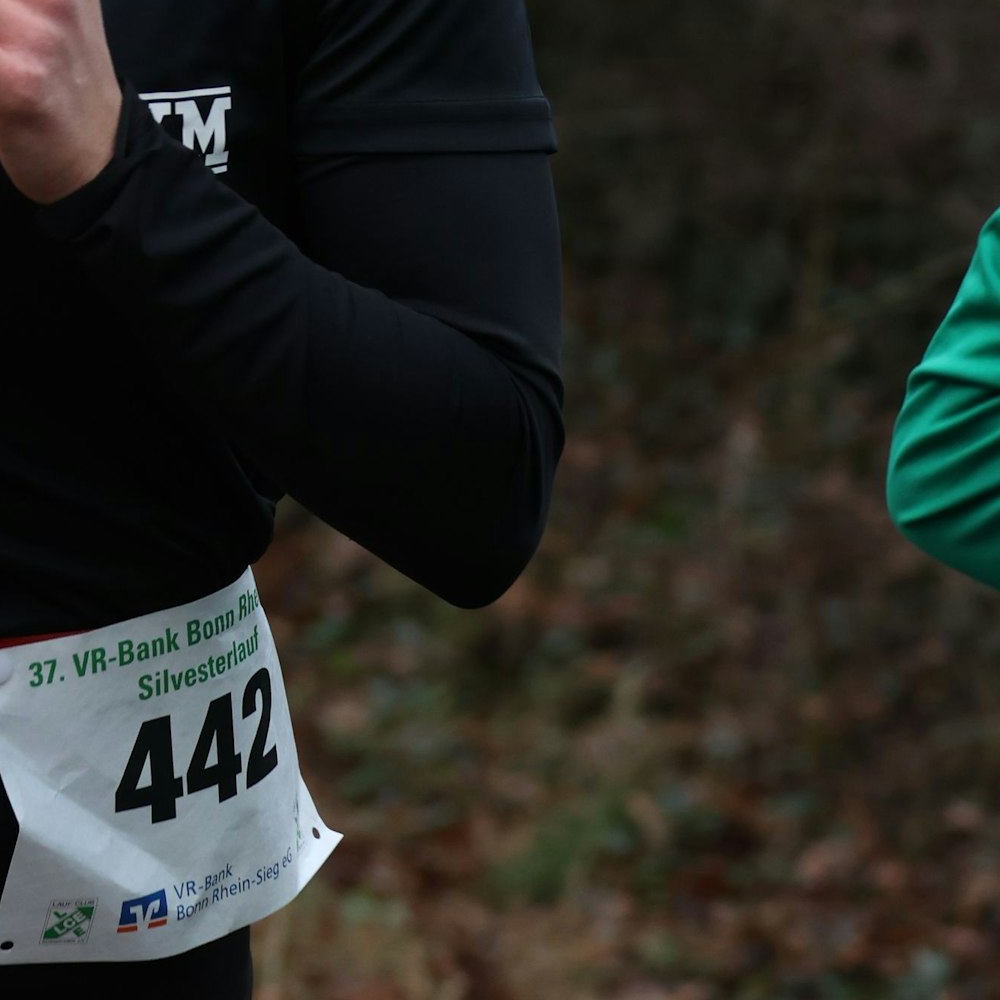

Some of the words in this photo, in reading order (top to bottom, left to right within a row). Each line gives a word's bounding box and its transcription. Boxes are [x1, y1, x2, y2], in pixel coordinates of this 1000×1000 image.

[28, 658, 66, 688] 37.
[72, 627, 181, 678] VR-Bank
[186, 608, 235, 647] Bonn
[138, 624, 259, 701] Silvesterlauf
[114, 667, 279, 825] 442
[173, 862, 233, 900] VR-Bank
[176, 895, 210, 921] Bonn
[212, 862, 280, 904] Rhein-Sieg
[281, 846, 293, 869] eG
